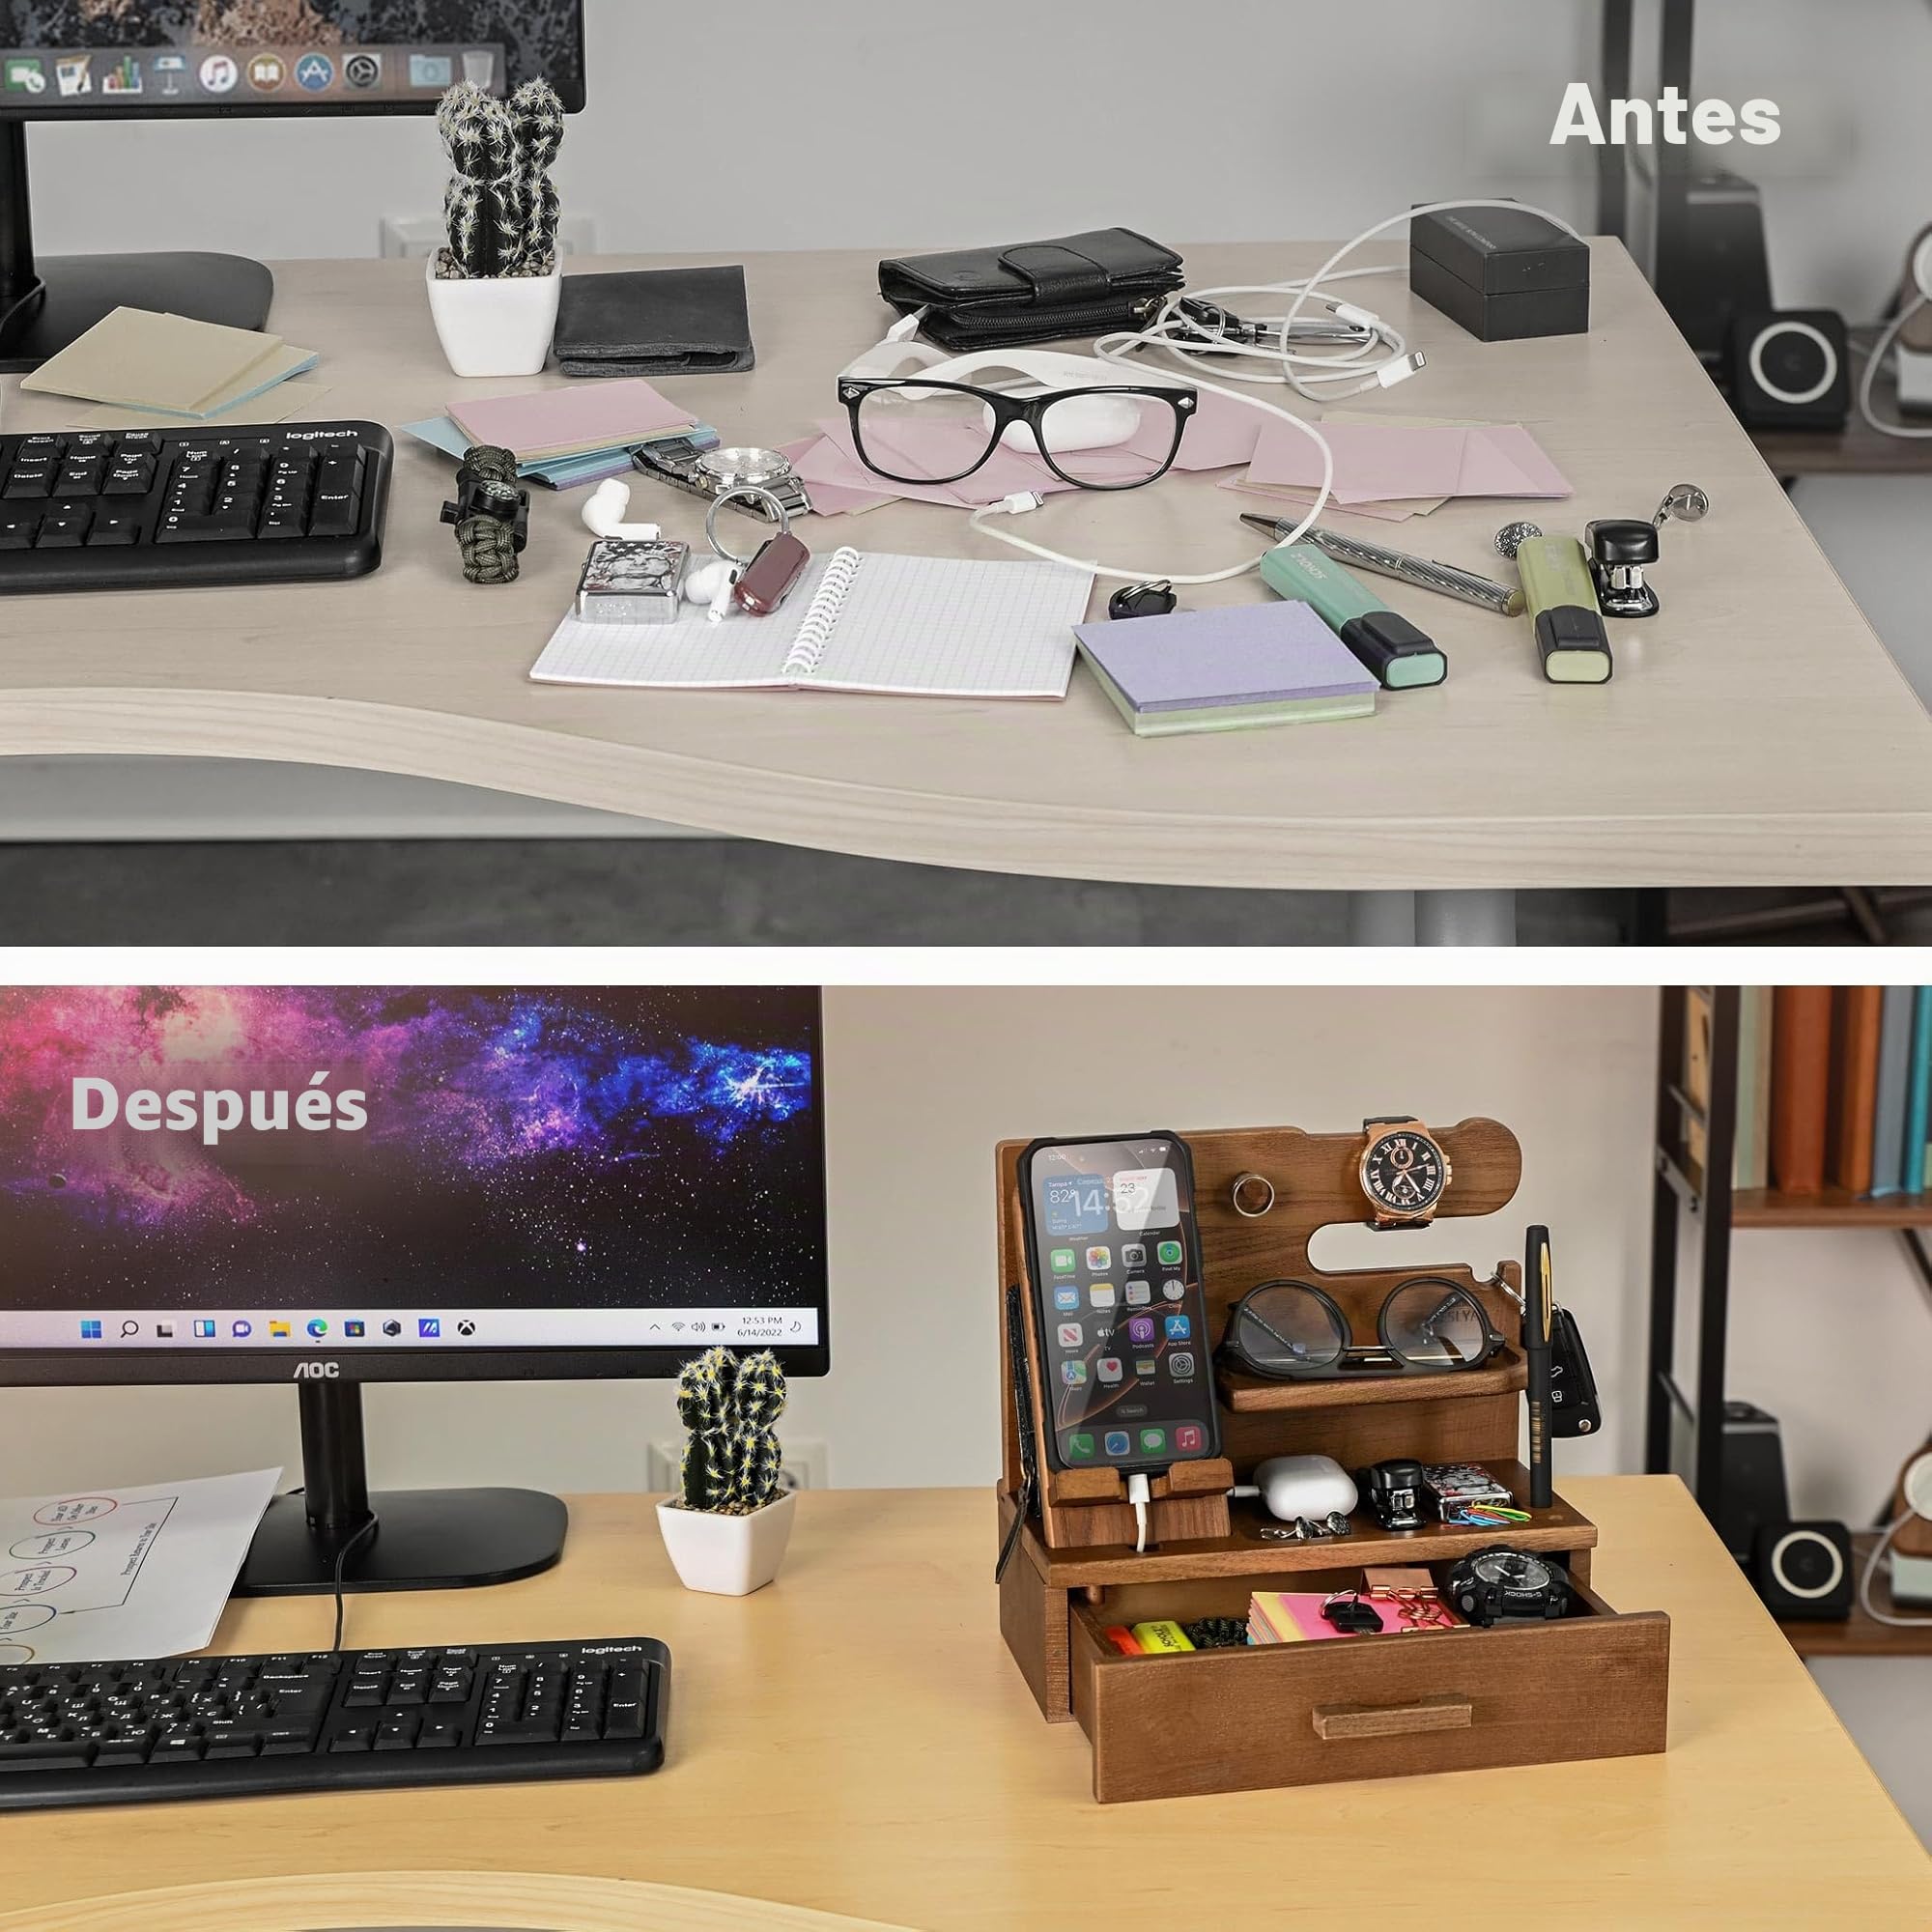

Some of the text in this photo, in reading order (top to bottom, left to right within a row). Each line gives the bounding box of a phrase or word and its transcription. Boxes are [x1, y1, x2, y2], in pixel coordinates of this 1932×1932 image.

[286, 430, 358, 440] logitech
[1120, 1182, 1136, 1194] 23
[737, 1328, 782, 1337] 6/14/2022
[293, 1361, 341, 1379] AOC
[582, 1645, 642, 1655] logitech
